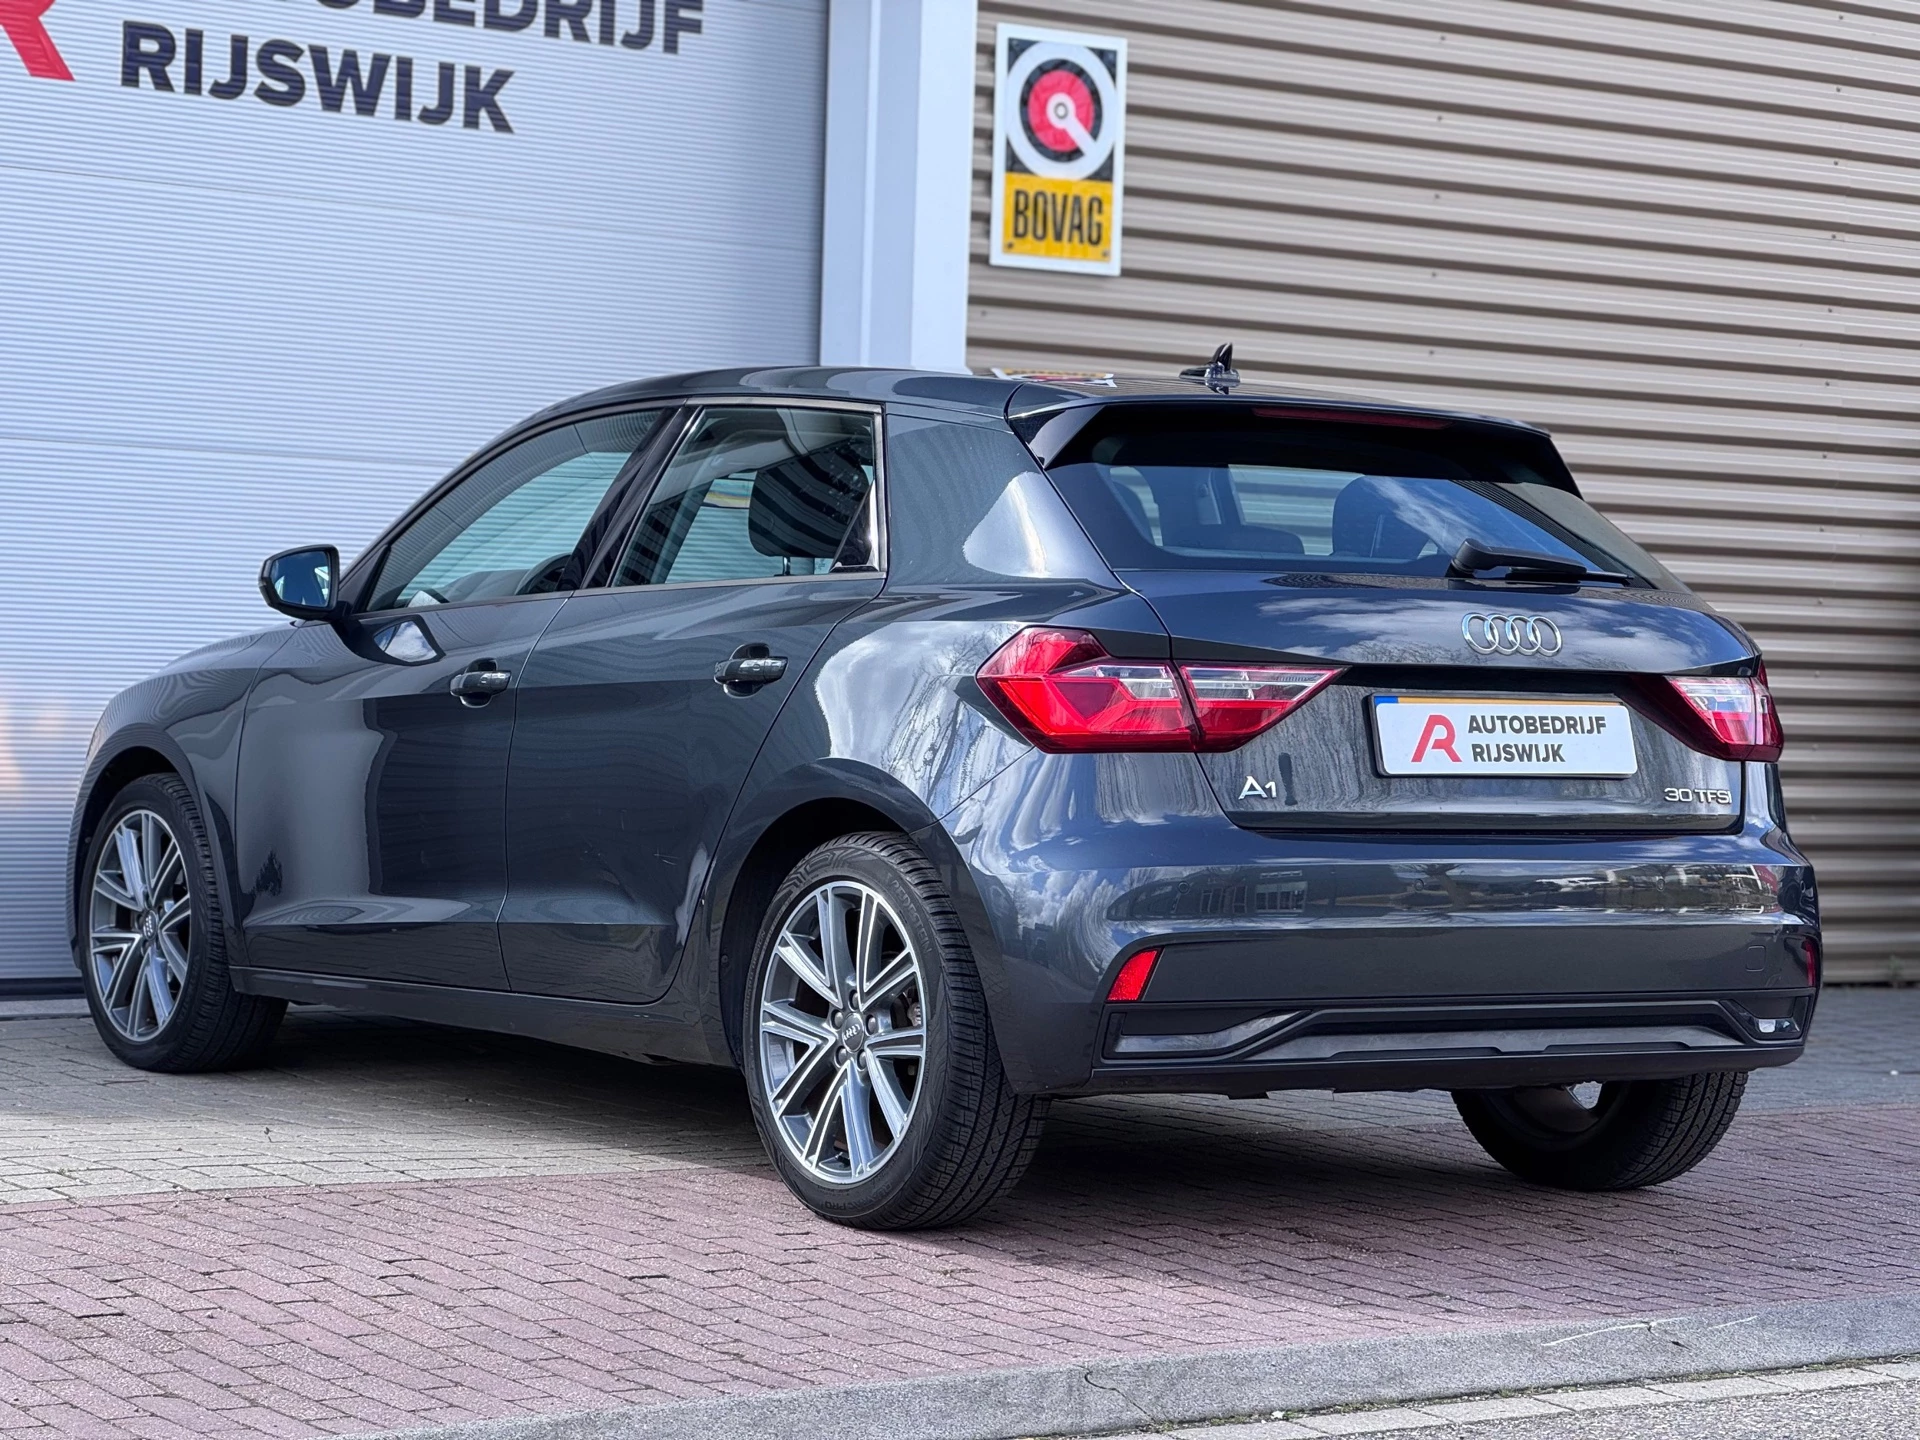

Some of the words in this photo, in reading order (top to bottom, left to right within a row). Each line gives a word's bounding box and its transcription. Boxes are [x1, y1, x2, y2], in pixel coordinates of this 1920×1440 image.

[314, 0, 703, 54] DRIJF
[121, 20, 516, 134] RIJSWIJK
[1014, 190, 1103, 246] BOVAG
[1468, 715, 1606, 734] AUTOBEDRIJF
[1472, 743, 1565, 762] RIJSWIJK
[1238, 775, 1277, 800] A1
[1664, 787, 1692, 802] 30
[1694, 789, 1732, 804] TFSI
